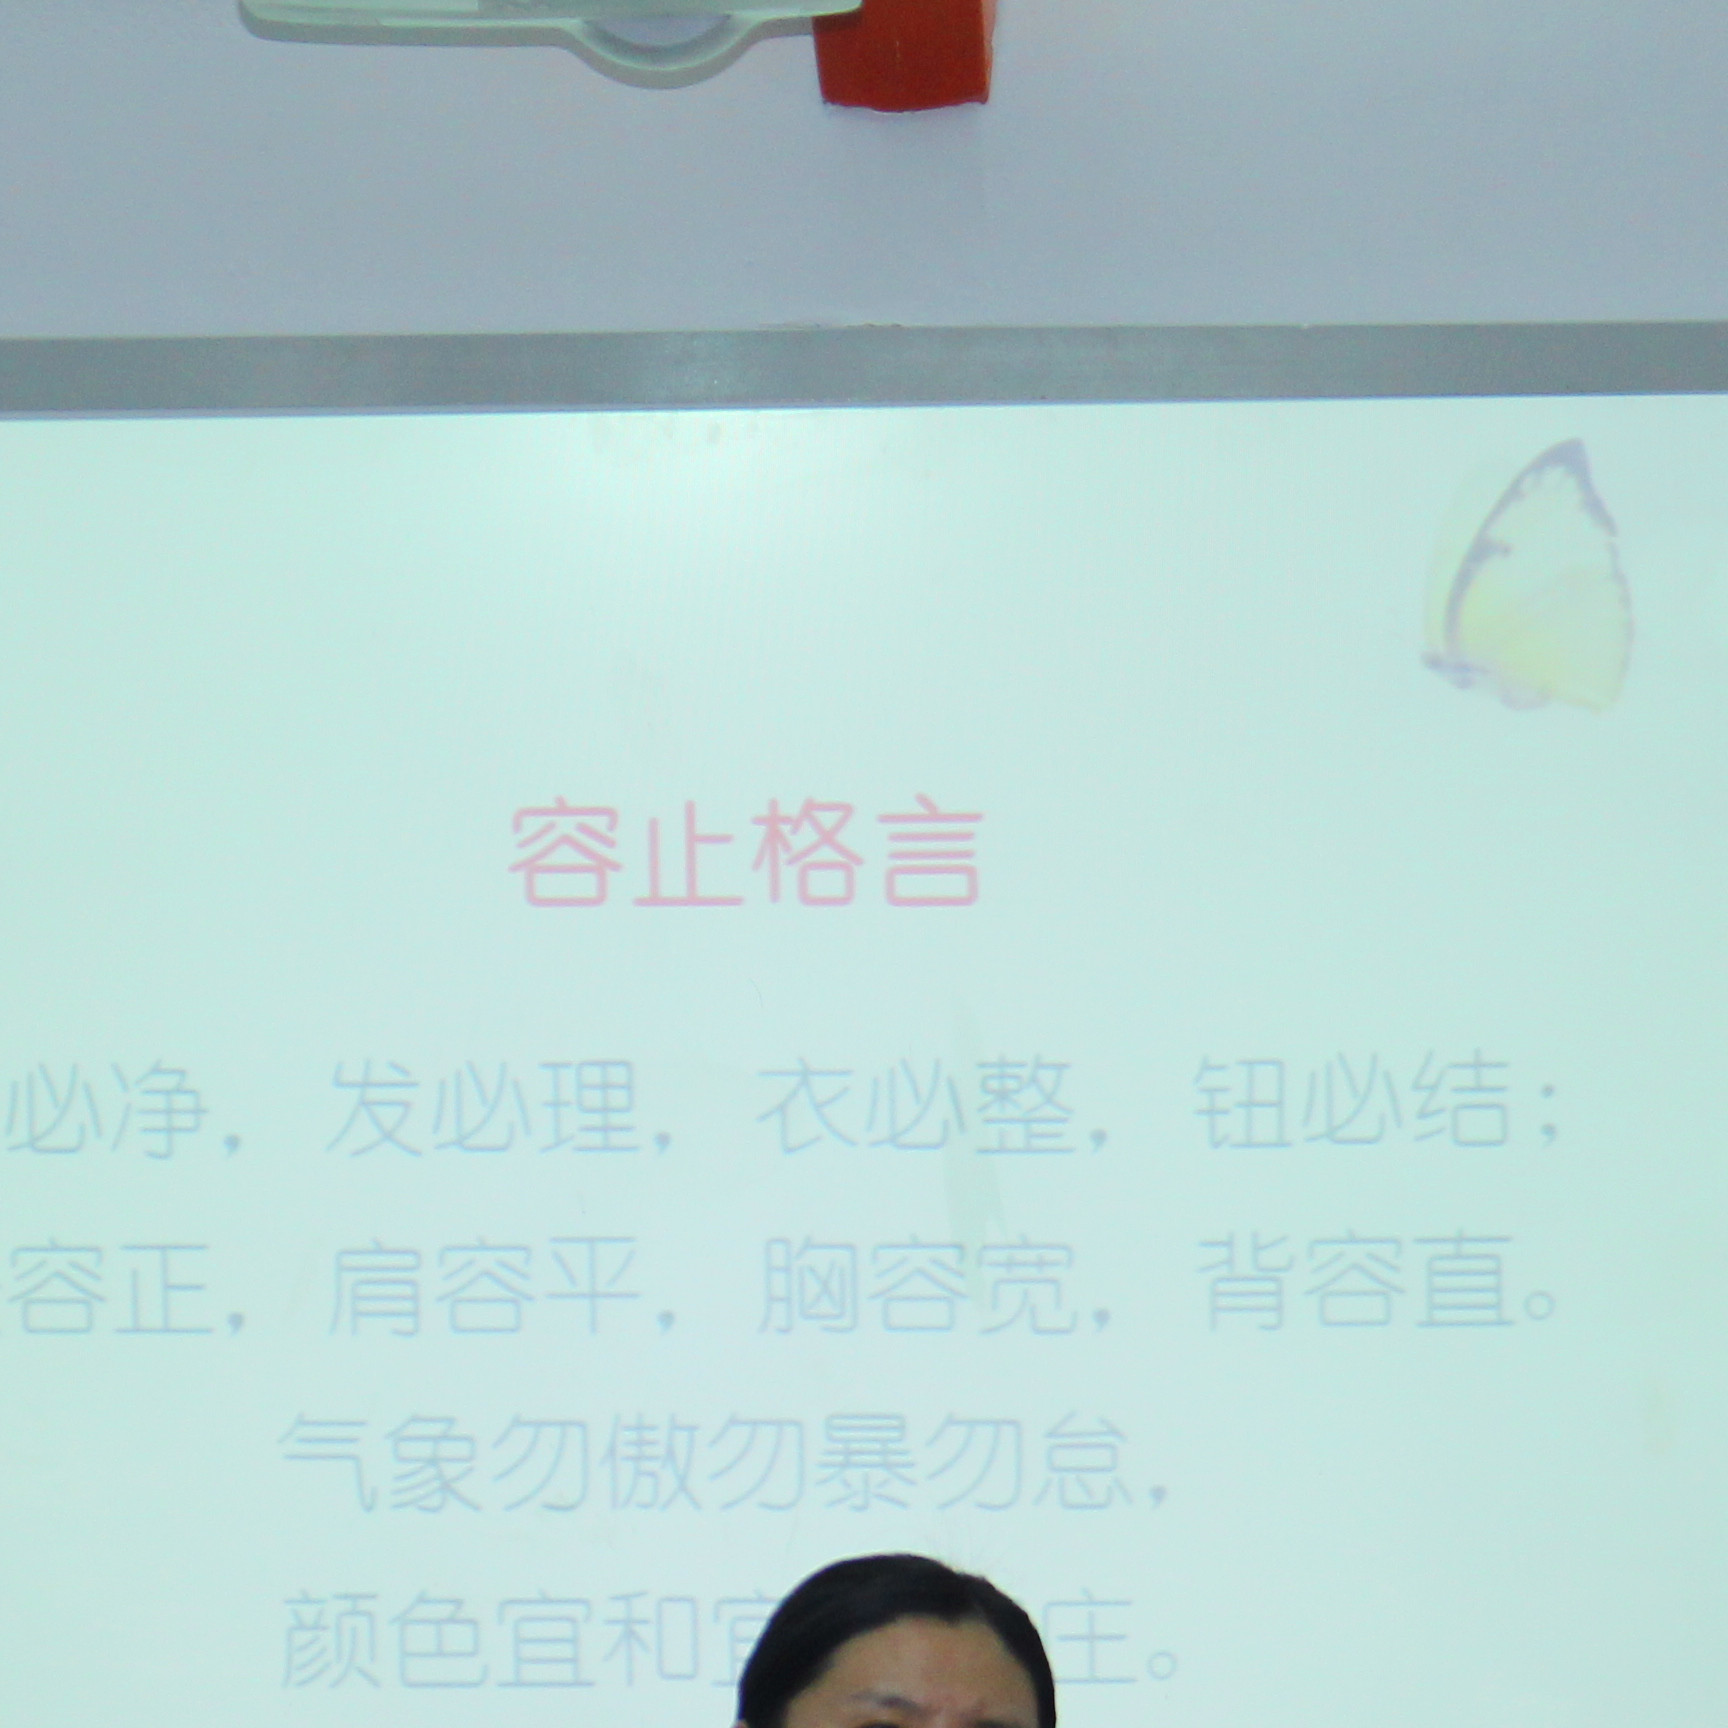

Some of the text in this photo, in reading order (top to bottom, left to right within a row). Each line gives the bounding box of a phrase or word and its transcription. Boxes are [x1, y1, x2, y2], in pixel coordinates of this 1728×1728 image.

[507, 792, 985, 908] 容止格言
[276, 1410, 1167, 1516] 气象勿傲勿暴勿怠，
